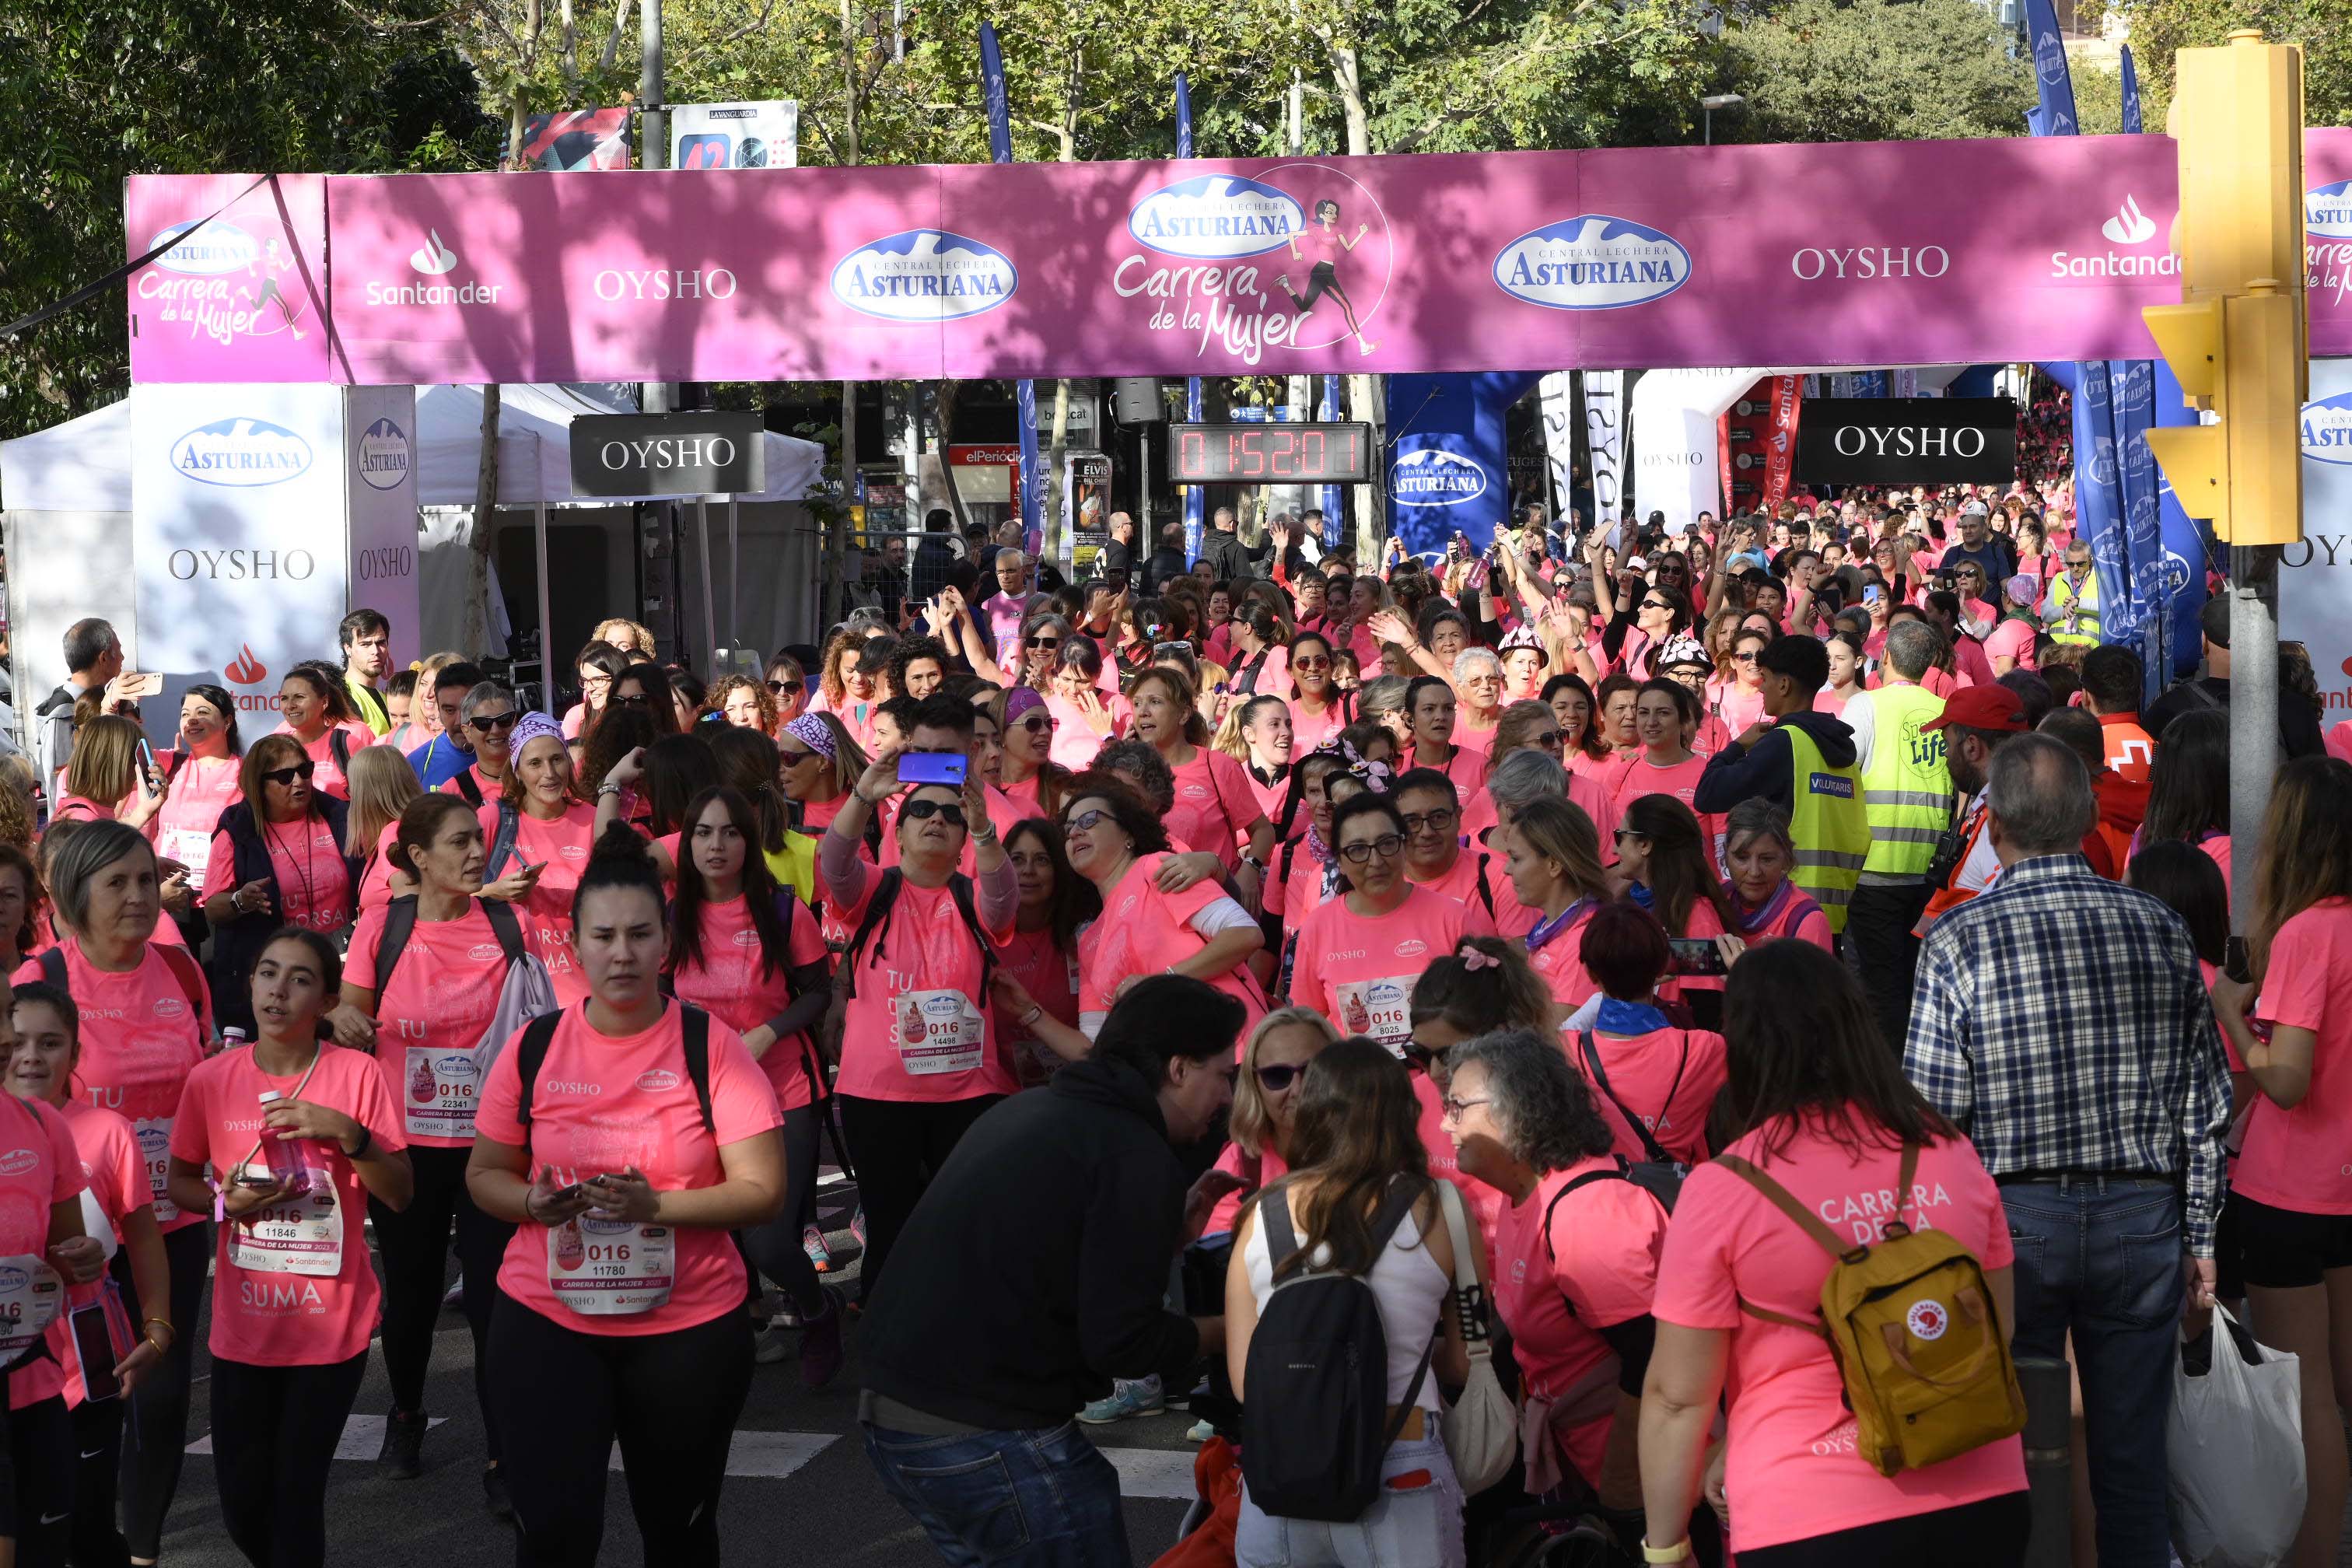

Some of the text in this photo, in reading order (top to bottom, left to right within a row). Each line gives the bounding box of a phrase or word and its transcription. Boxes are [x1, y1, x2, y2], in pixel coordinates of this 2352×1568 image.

[1230, 201, 1286, 211] LECHERA
[1142, 207, 1290, 238] ASTURIANA
[1538, 245, 1670, 259] CENTRAL LECHERA
[874, 261, 997, 271] CENTRAL LECHERA
[1508, 251, 1676, 286] ASTURIANA
[1792, 246, 1950, 279] OYSHO
[138, 271, 229, 299] Carrera
[593, 268, 737, 301] OYSHO
[846, 264, 1003, 297] ASTURIANA
[1114, 255, 1258, 298] Carrera
[2323, 267, 2338, 288] la
[366, 282, 503, 306] Santander
[161, 297, 263, 345] de la Mujer
[1149, 292, 1314, 366] de la Mujer
[1835, 425, 1985, 457] OYSHO
[181, 443, 303, 469] ASTURIANA
[362, 441, 407, 472] ASTURIANA
[602, 438, 736, 471] OYSHO
[1643, 452, 1703, 466] OYSHO
[1083, 465, 1108, 475] ELVIS
[1391, 472, 1479, 493] ASTURIANA
[1769, 456, 1787, 509] Sports
[168, 549, 314, 580] OYSHO
[359, 546, 411, 580] OYSHO
[1910, 733, 1948, 767] Life
[1327, 949, 1367, 962] OYSHO
[887, 969, 914, 992] TU
[1367, 992, 1400, 1003] ASTURIANA
[79, 1008, 124, 1021] OYSHO
[1372, 1010, 1403, 1025] 016
[397, 1018, 426, 1039] TU
[929, 1021, 959, 1035] 016
[1380, 1025, 1400, 1035] 8025
[933, 1037, 956, 1046] 14498
[910, 1048, 935, 1057] CARRERA
[438, 1062, 475, 1073] ASTURIANA
[908, 1060, 937, 1069] OYSHO
[86, 1086, 124, 1108] TU
[439, 1083, 473, 1097] 016
[548, 1080, 600, 1096] OYSHO
[442, 1100, 467, 1108] 22341
[414, 1122, 443, 1130] OYSHO
[262, 1208, 303, 1223] 016
[241, 1237, 266, 1247] CARRERA
[265, 1228, 296, 1238] 11846
[236, 1250, 332, 1266] OYSHO Santander
[588, 1244, 631, 1261] 016
[593, 1265, 625, 1276] 11780
[241, 1280, 322, 1308] SUMA
[1811, 1437, 1858, 1456] OYS
